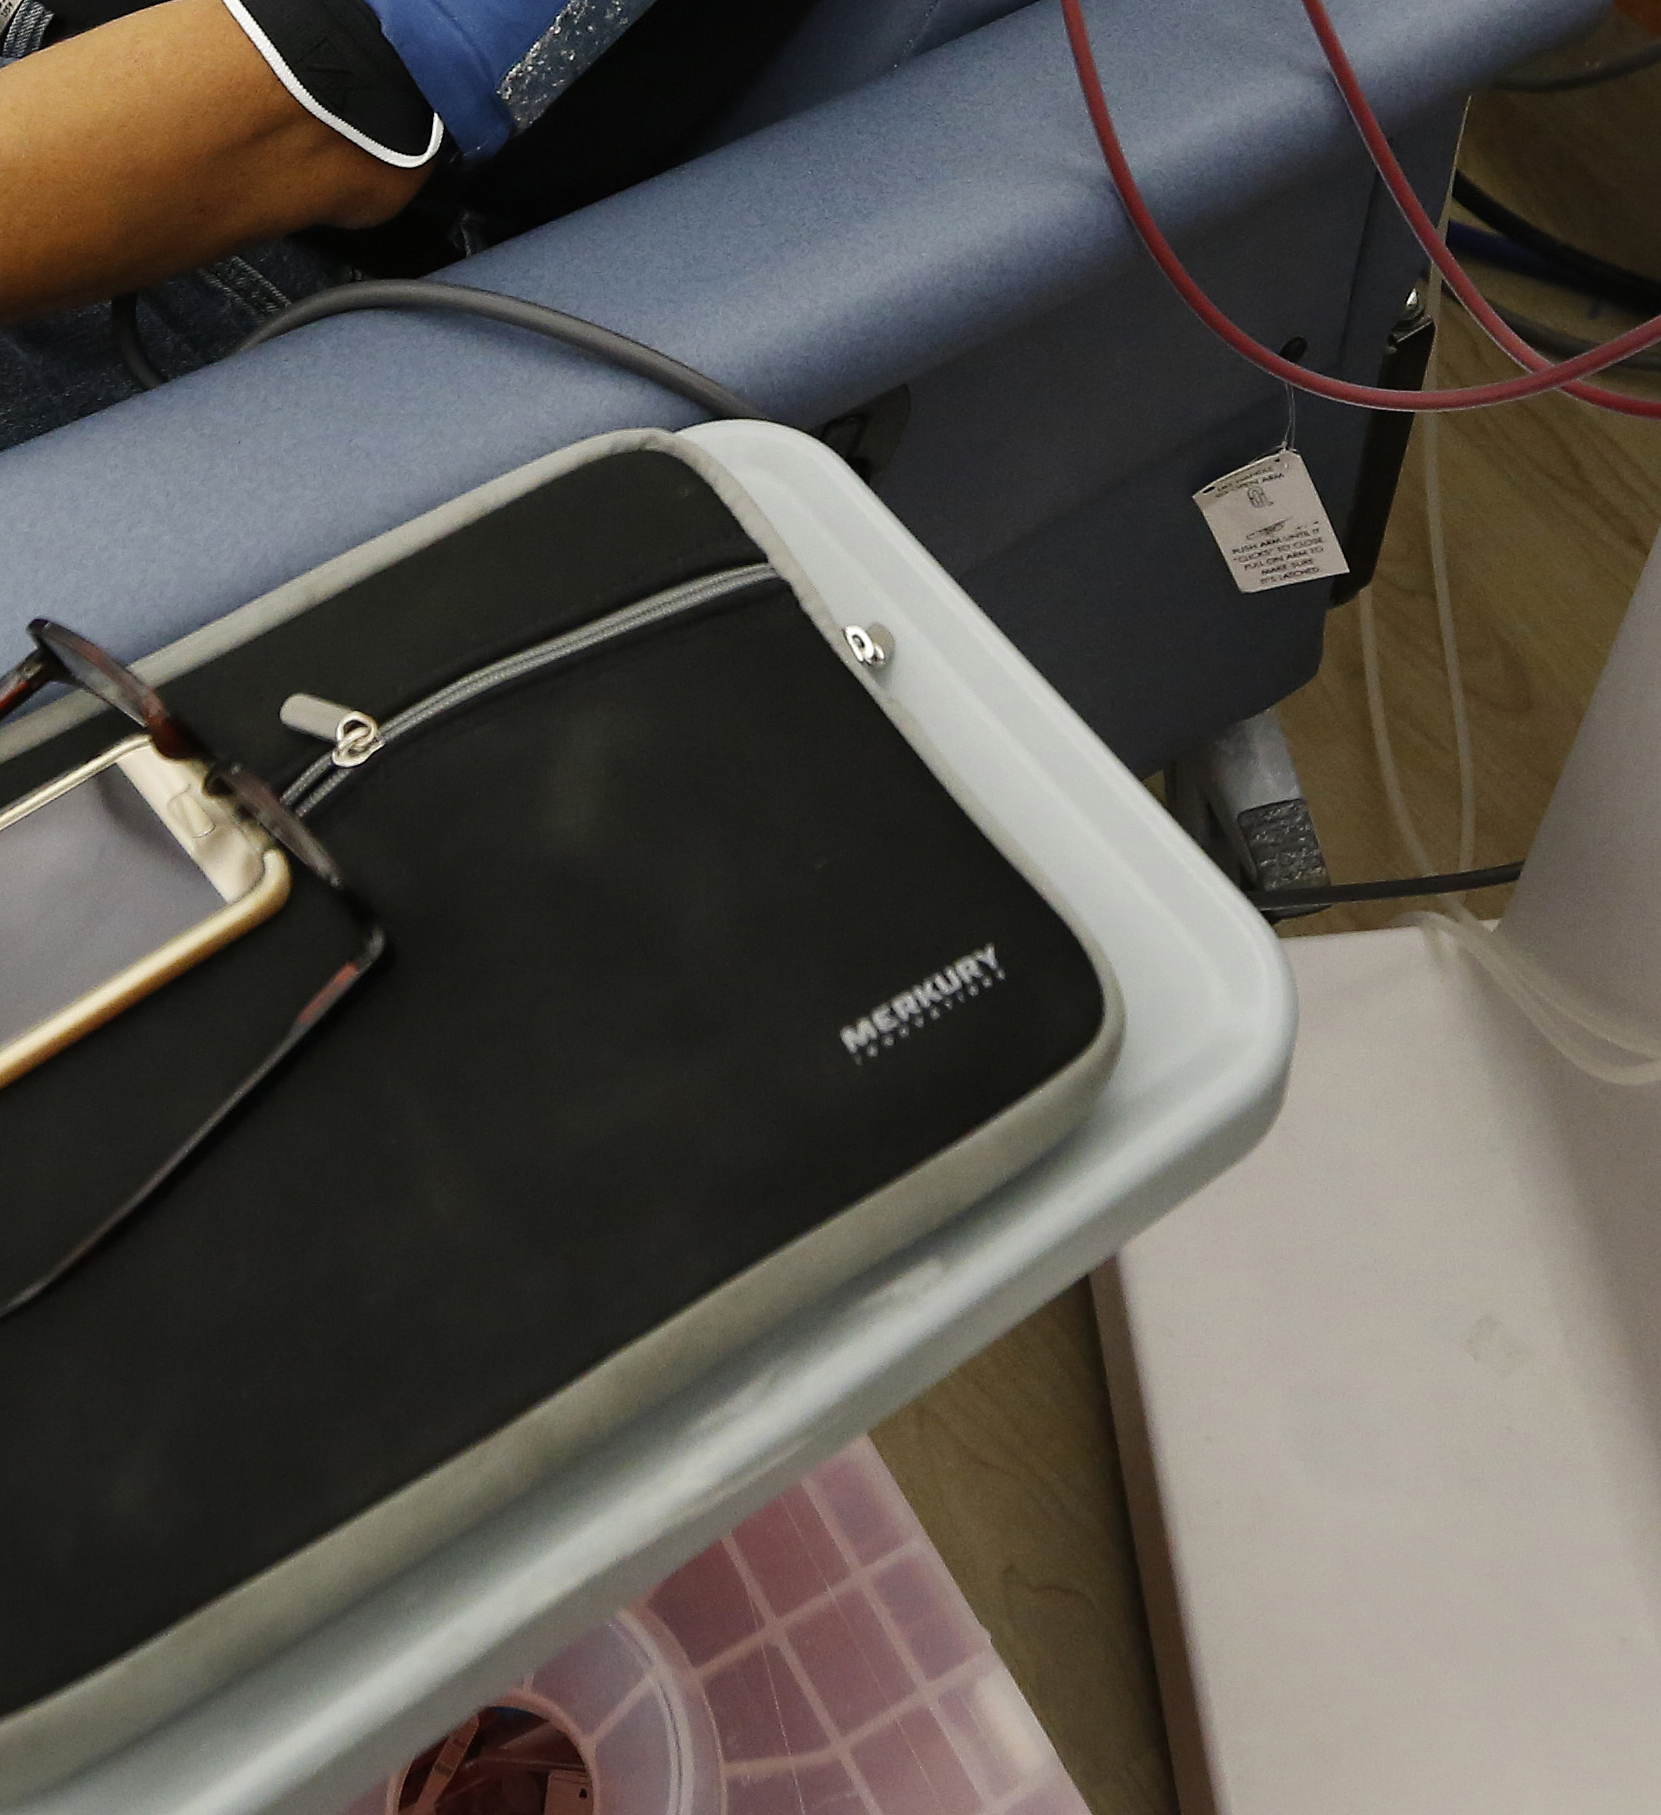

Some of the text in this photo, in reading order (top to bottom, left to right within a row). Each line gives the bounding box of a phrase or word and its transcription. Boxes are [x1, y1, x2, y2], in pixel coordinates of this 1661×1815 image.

[1262, 472, 1285, 483] ARM
[1232, 543, 1257, 555] PUSH
[1260, 538, 1281, 550] ARM
[1286, 549, 1308, 560] ARM
[839, 941, 999, 1054] MERKURY
